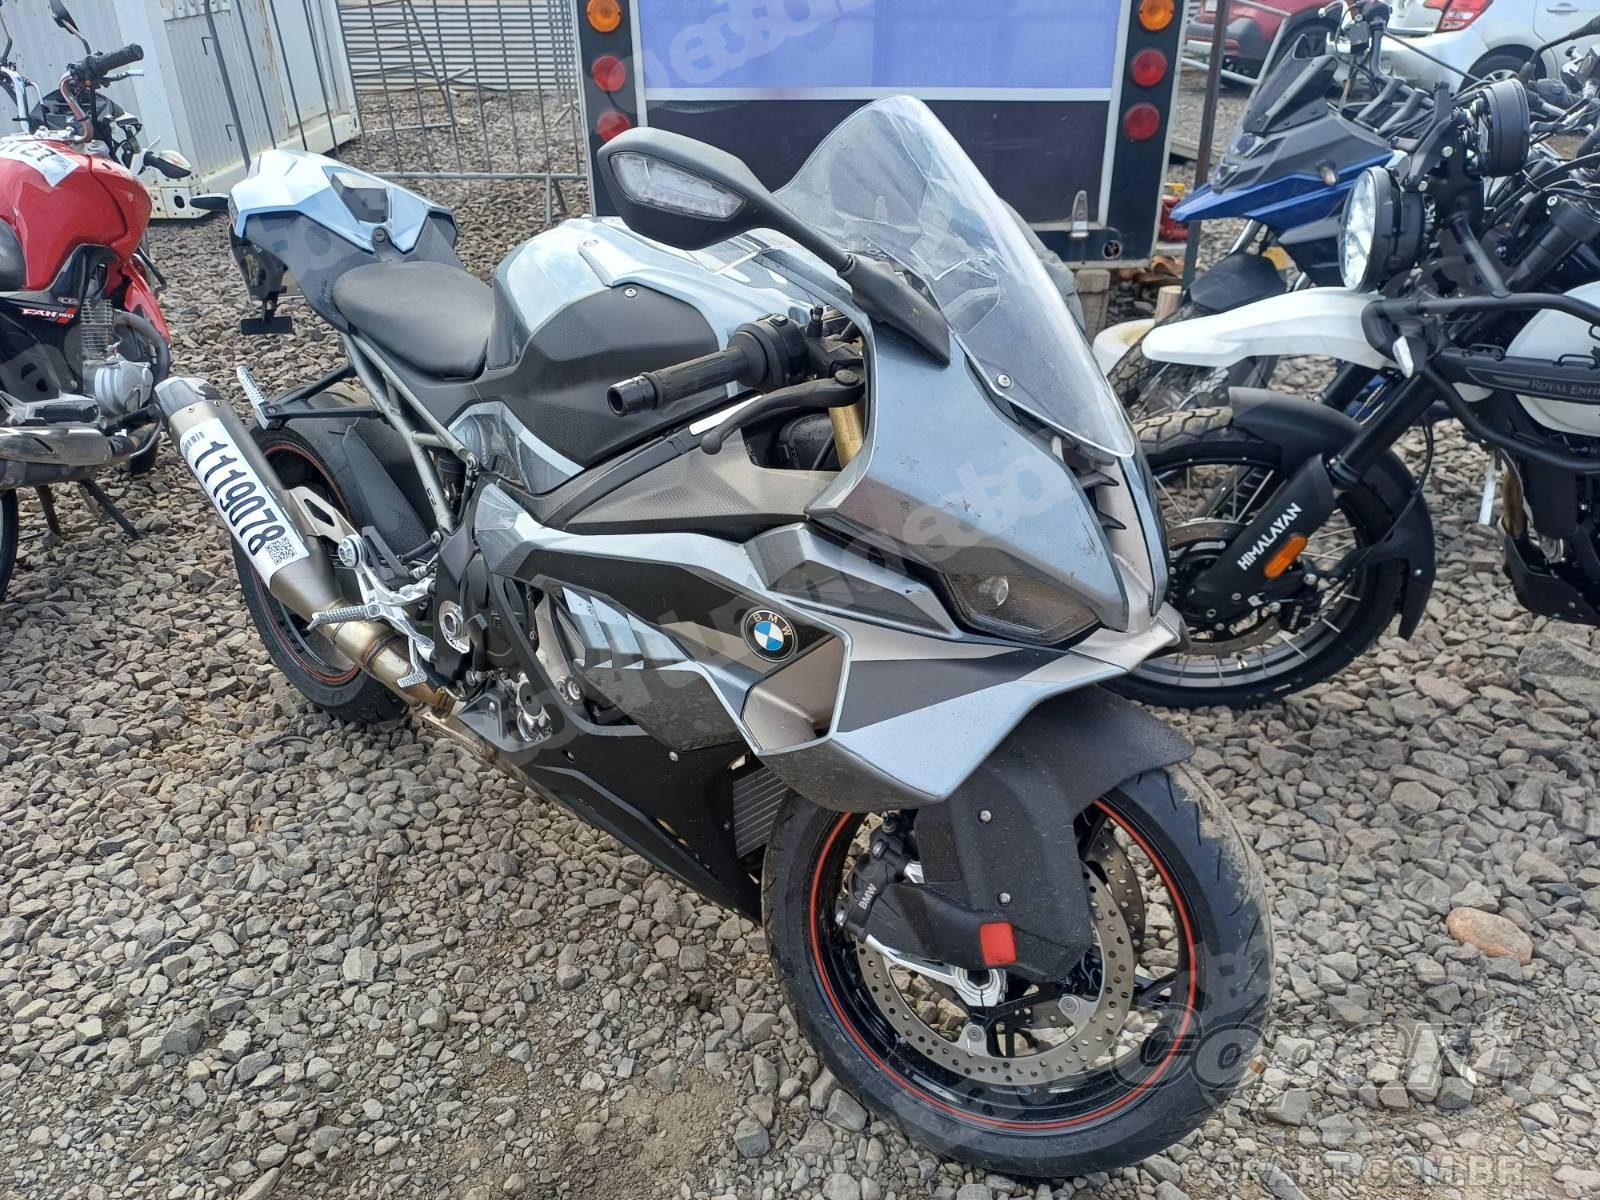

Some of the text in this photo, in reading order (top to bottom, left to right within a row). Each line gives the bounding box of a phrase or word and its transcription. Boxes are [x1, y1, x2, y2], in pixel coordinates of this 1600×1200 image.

[21, 308, 57, 317] FAN
[1530, 380, 1567, 393] ROYAL
[194, 440, 286, 557] 1119078
[1236, 502, 1303, 571] HIMALAYAN
[752, 612, 793, 636] BMW
[858, 882, 877, 910] BMW
